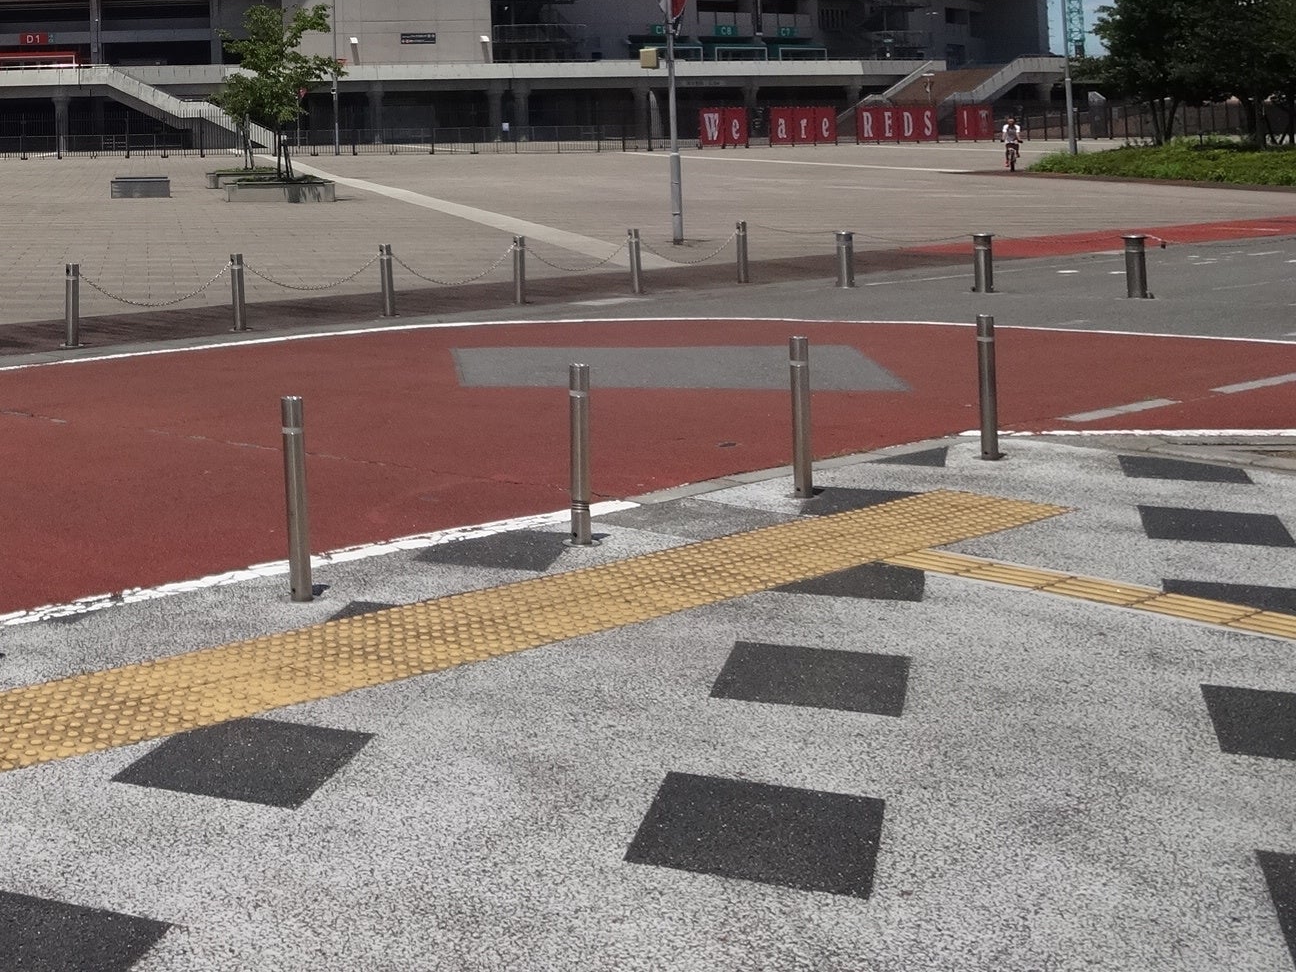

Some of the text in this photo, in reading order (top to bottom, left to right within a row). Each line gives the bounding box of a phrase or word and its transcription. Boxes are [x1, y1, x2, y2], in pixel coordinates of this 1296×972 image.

[26, 34, 40, 44] D1
[704, 113, 740, 141] We
[777, 115, 830, 139] are
[862, 110, 933, 138] REDS
